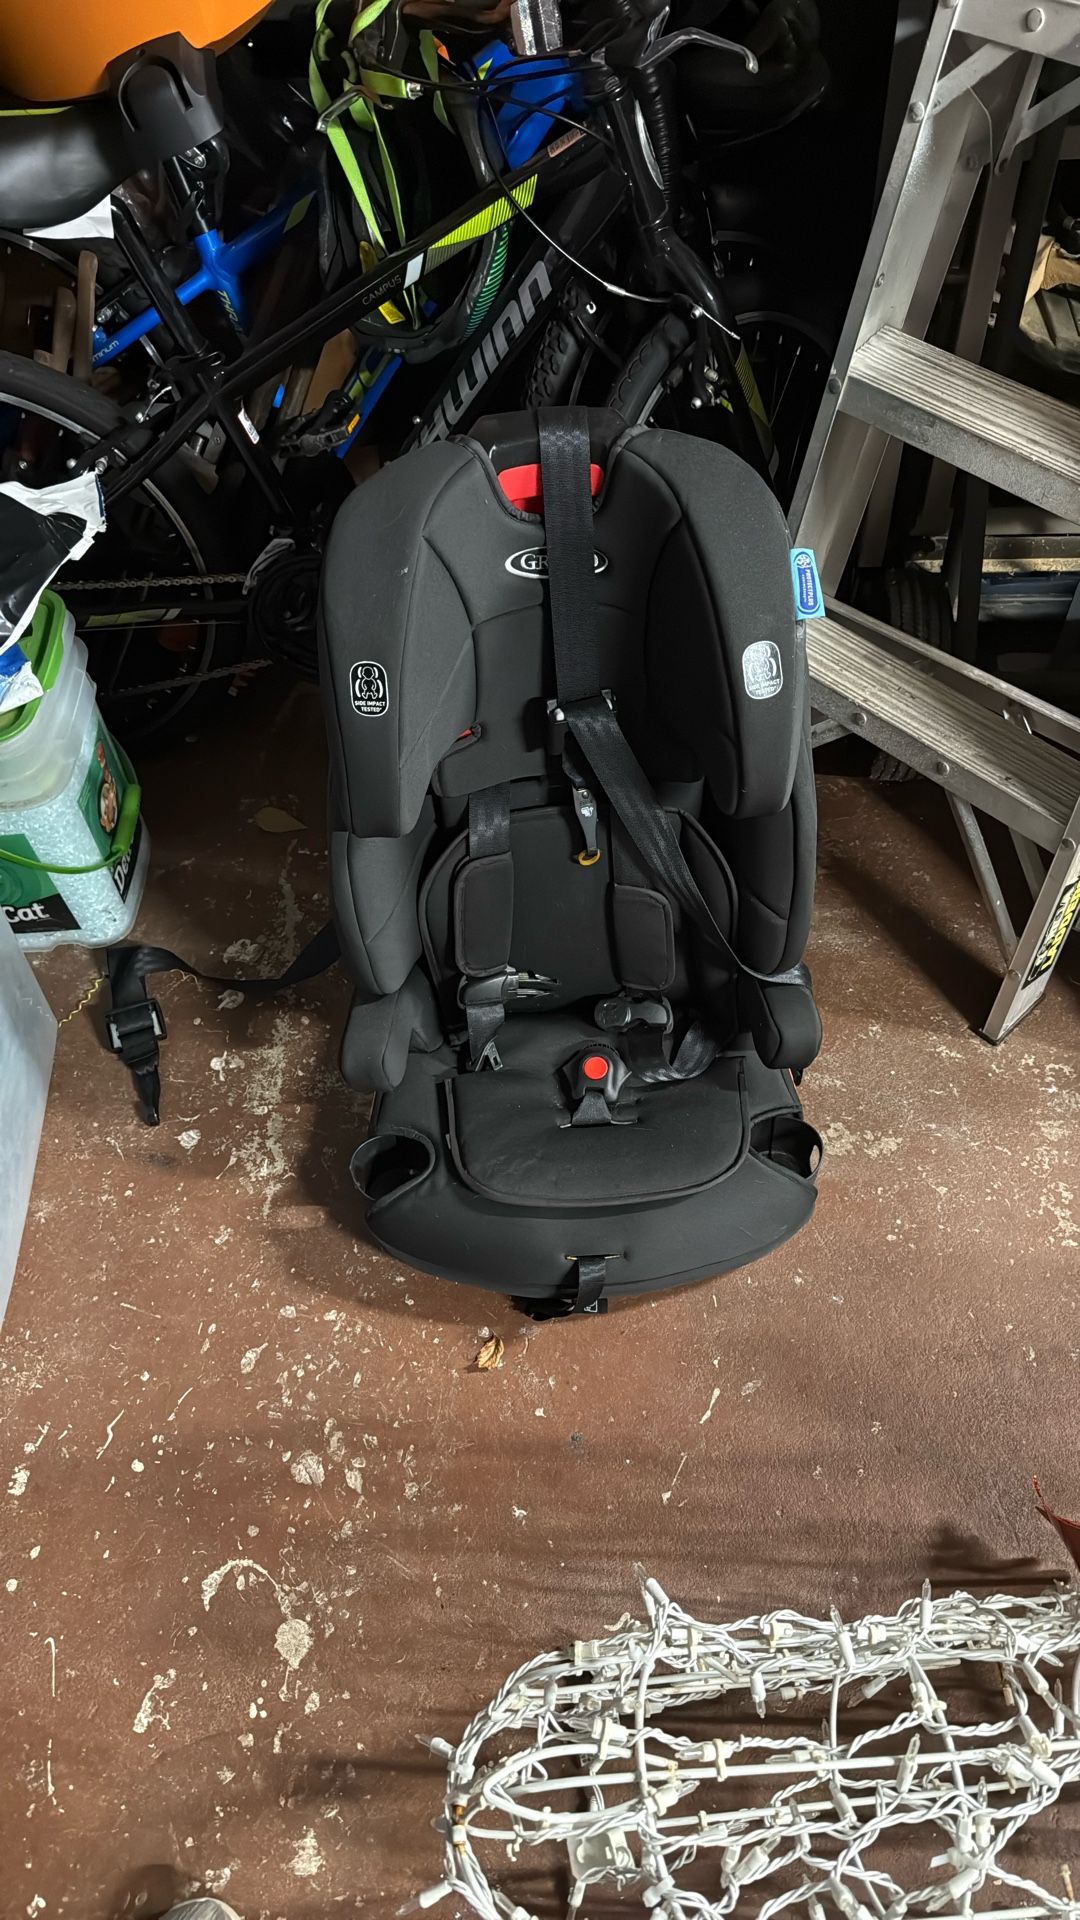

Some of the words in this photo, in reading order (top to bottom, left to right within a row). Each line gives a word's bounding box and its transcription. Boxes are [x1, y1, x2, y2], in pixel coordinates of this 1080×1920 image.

[362, 274, 402, 305] CAMPUS
[805, 569, 814, 606] PROTECTPLUS
[2, 902, 50, 924] Cat
